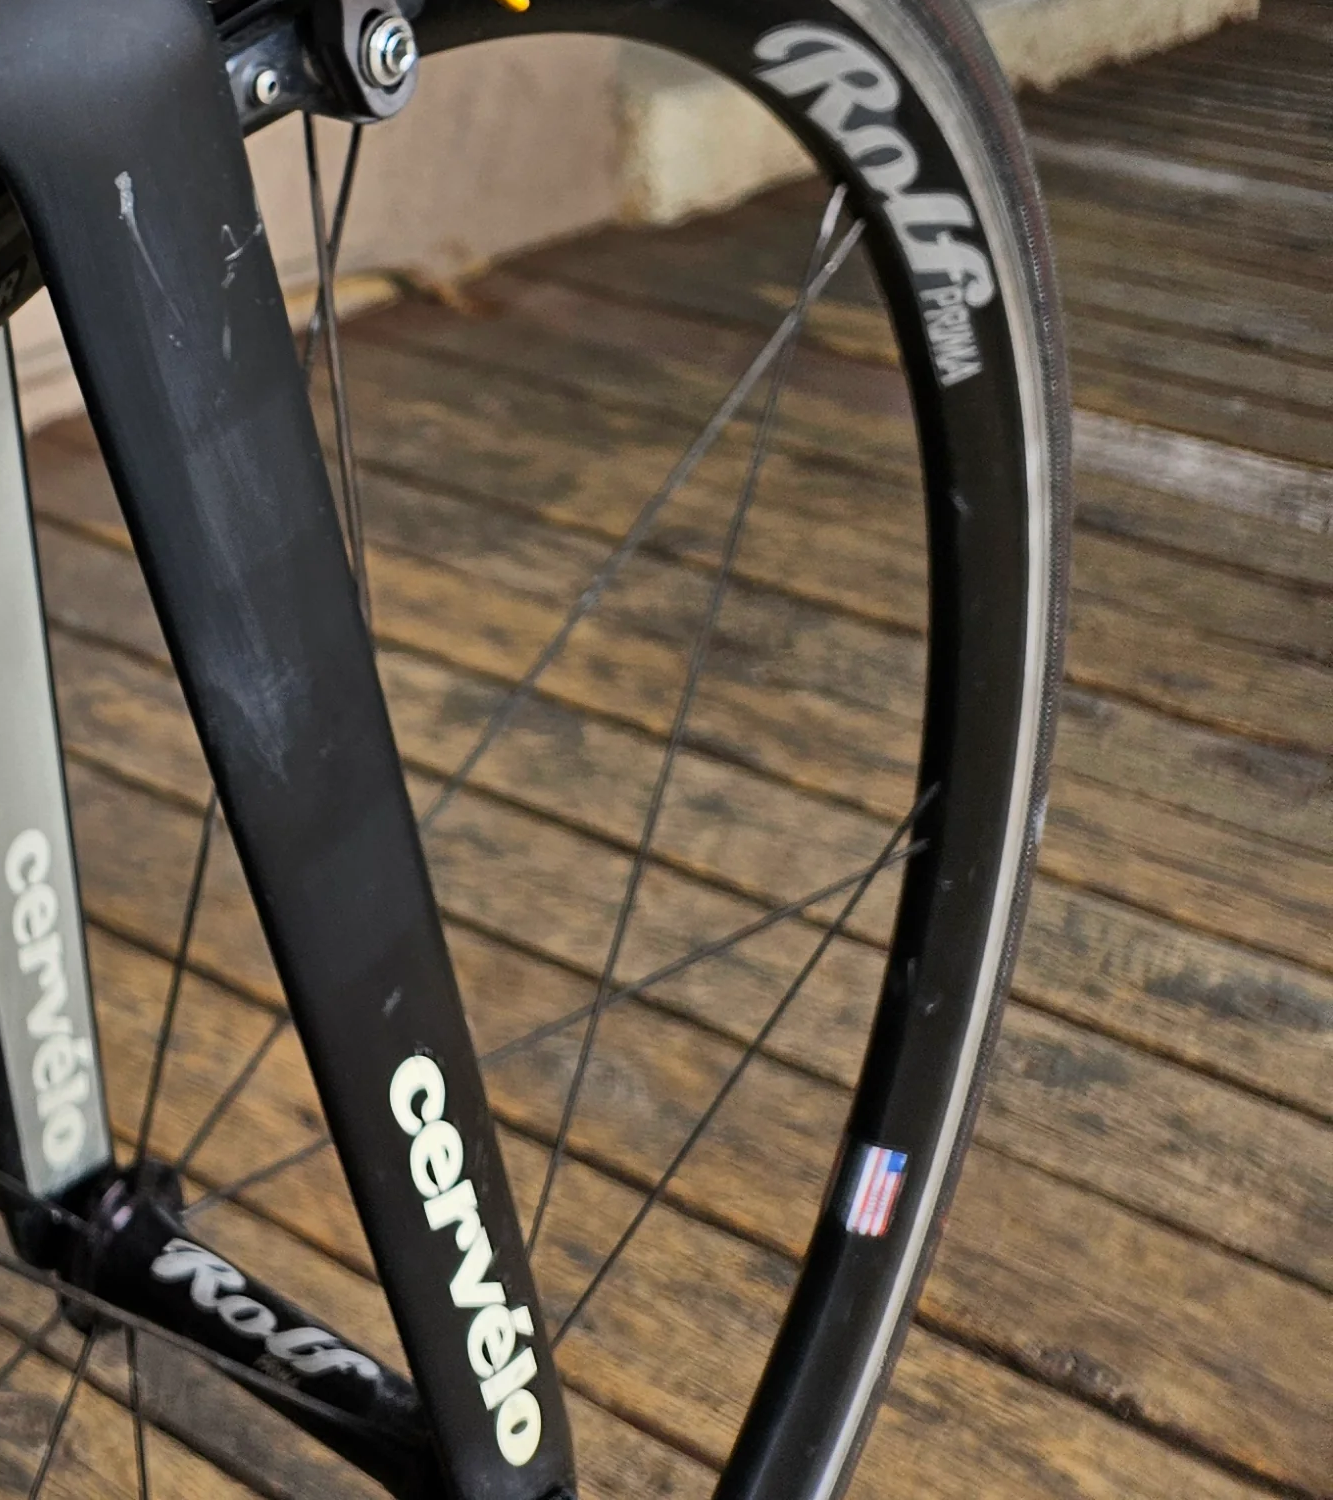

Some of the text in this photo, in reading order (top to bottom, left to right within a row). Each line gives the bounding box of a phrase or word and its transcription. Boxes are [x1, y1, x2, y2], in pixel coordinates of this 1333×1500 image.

[753, 21, 995, 307] Rolf
[4, 829, 93, 1163] cervélo
[151, 1238, 380, 1380] Rolf
[390, 1055, 542, 1466] cervélo
